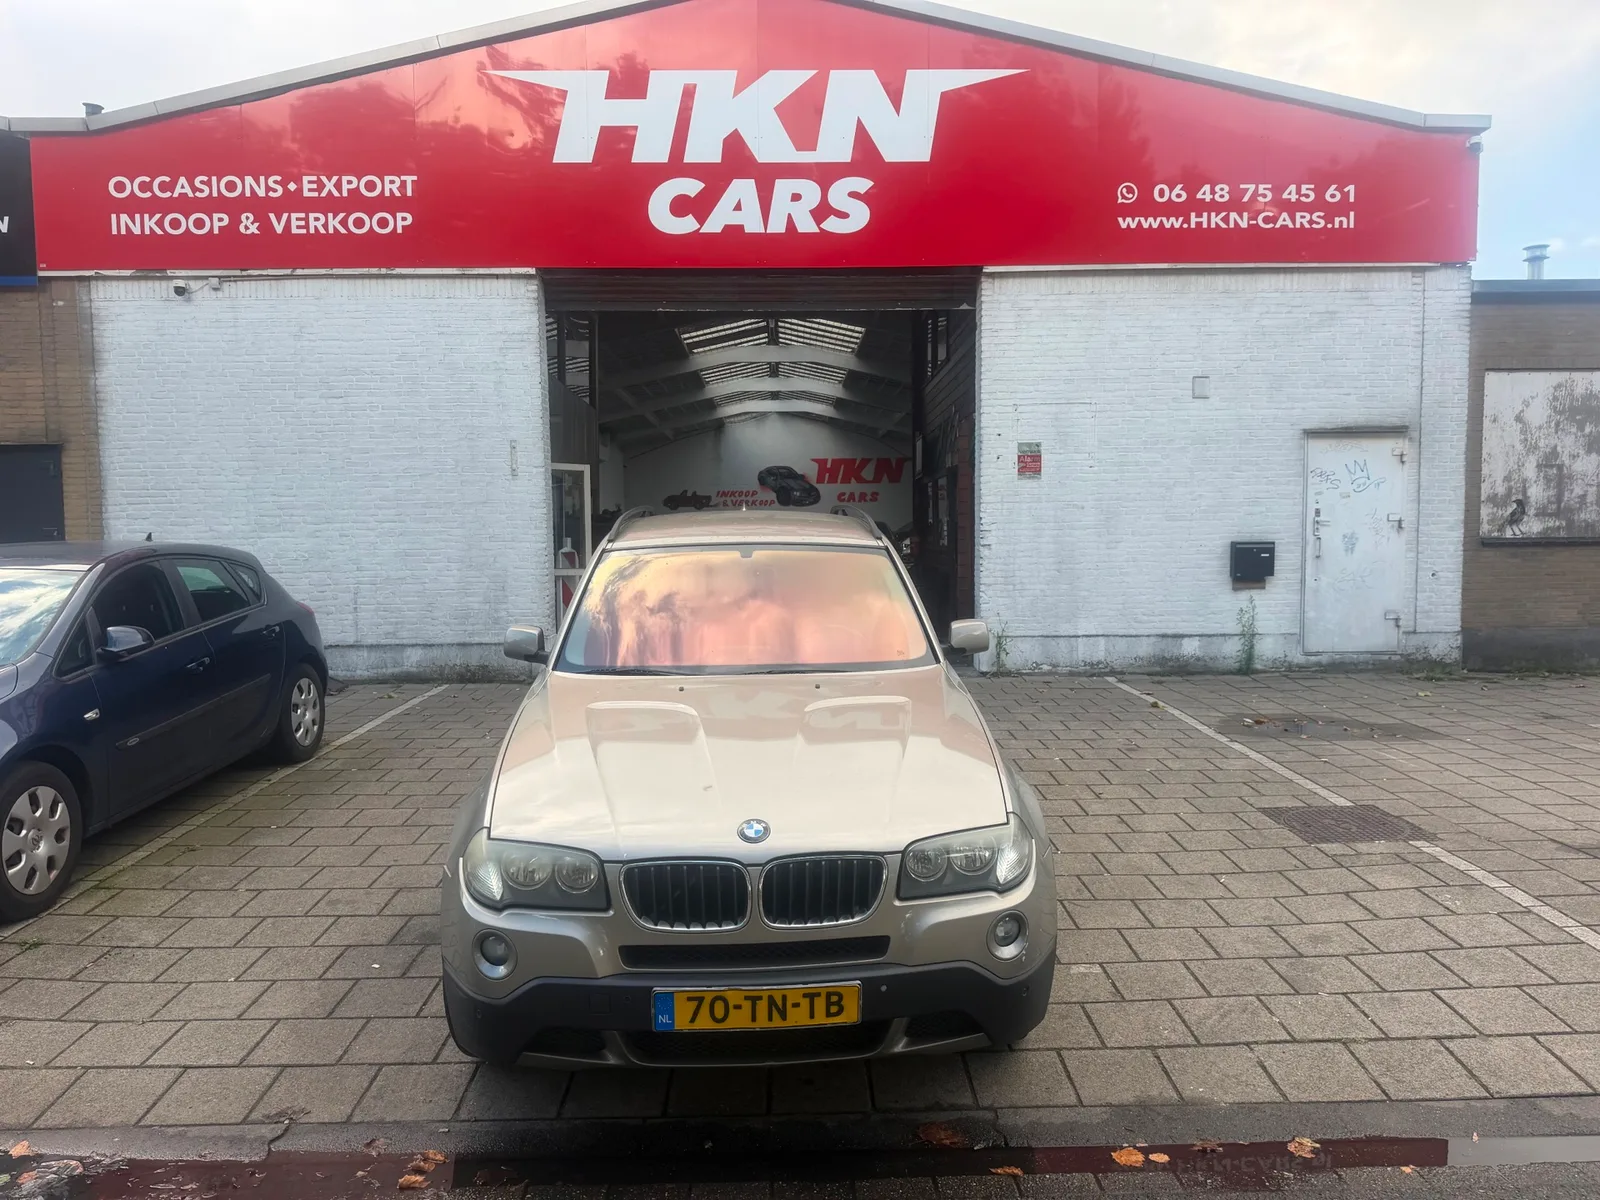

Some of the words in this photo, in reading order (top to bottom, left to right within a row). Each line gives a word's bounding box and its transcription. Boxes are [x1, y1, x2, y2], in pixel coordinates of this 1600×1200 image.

[486, 69, 1028, 164] HKN
[108, 175, 283, 199] OCCASIONS
[303, 175, 418, 198] EXPORT
[1153, 183, 1187, 203] 06
[1196, 183, 1230, 203] 48
[1239, 183, 1273, 203] 75
[1282, 184, 1316, 203] 45
[1324, 184, 1355, 203] 61
[648, 176, 875, 235] CARS
[110, 212, 230, 235] INKOOP
[239, 212, 261, 235] &
[268, 212, 413, 235] VERKOOP
[1117, 211, 1355, 229] www.HKN-CARS.nl
[810, 458, 908, 484] HKN
[716, 490, 758, 498] INKOOP
[731, 499, 775, 507] VERKOOP
[837, 491, 879, 503] CARS
[686, 991, 845, 1024] 70-TN-TB
[658, 1014, 672, 1024] NL
